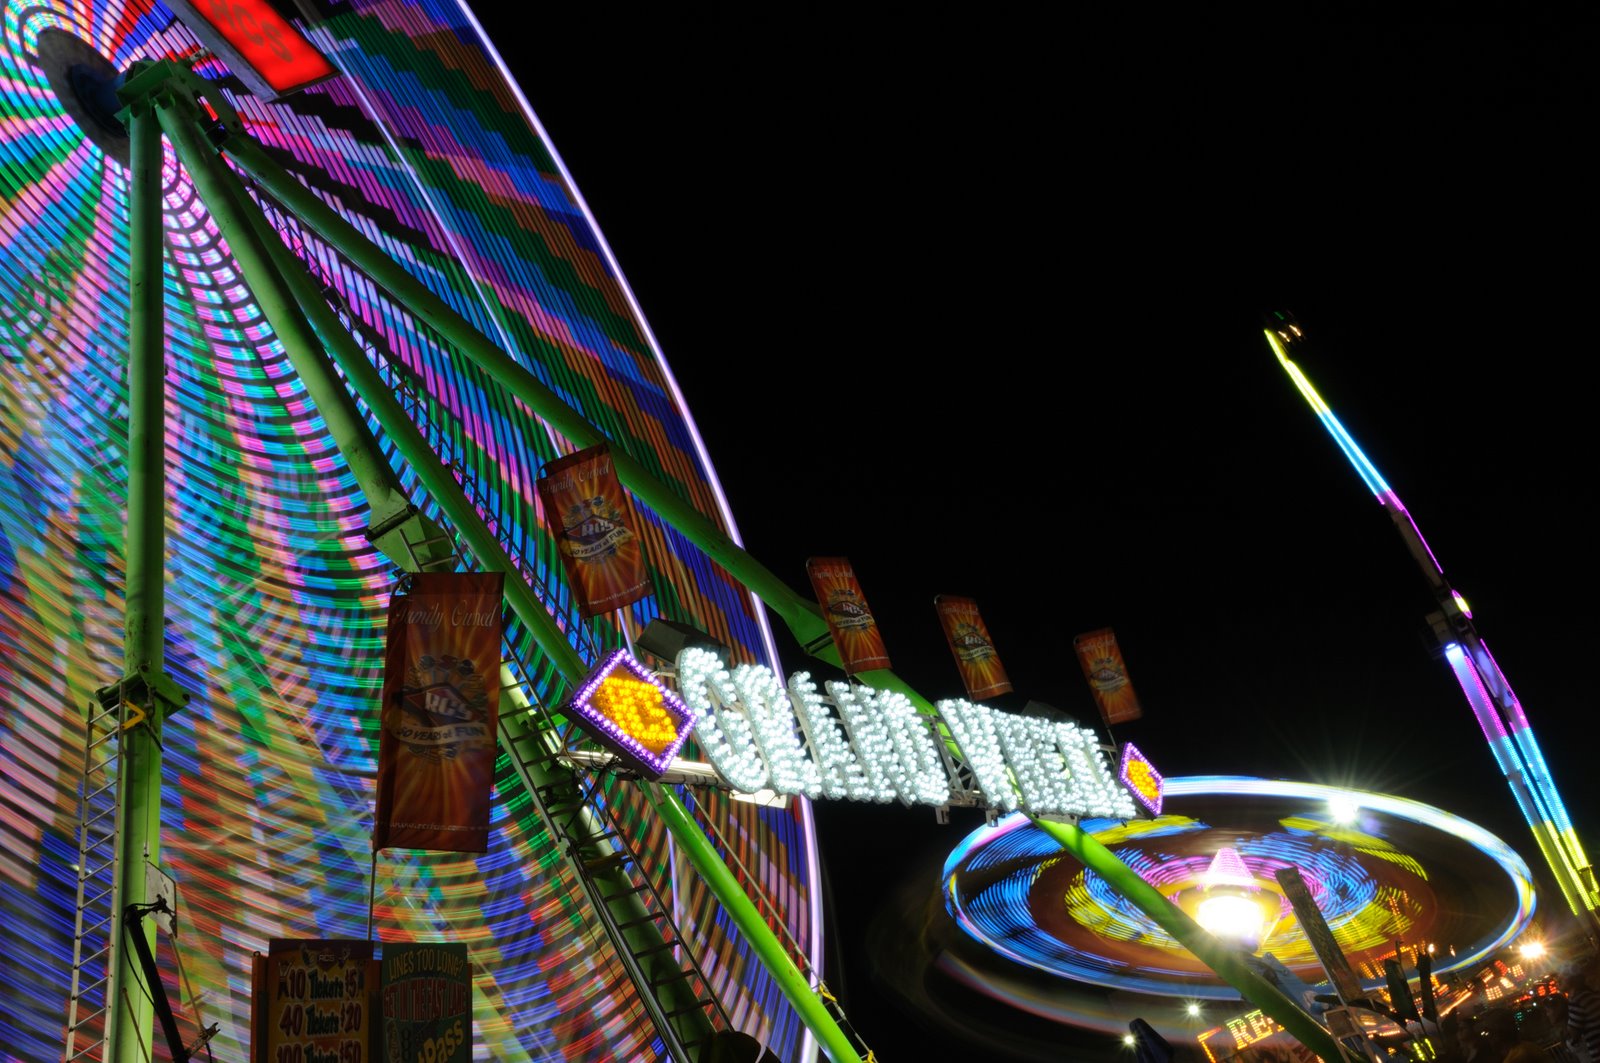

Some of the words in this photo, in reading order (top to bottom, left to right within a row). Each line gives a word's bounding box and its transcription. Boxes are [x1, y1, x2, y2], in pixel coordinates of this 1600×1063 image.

[451, 600, 500, 627] Owned
[425, 690, 473, 722] RCS
[455, 726, 486, 738] FUN
[675, 647, 949, 807] GRAND
[935, 698, 1137, 818] WHEEL
[388, 950, 415, 982] LINES
[416, 948, 435, 974] TOO
[437, 949, 464, 980] LONG?
[289, 968, 307, 999] 10
[307, 968, 345, 999] Tickets
[345, 967, 361, 999] $5
[280, 1004, 305, 1037] 40
[306, 1003, 340, 1036] Tickets
[341, 1001, 363, 1034] $20
